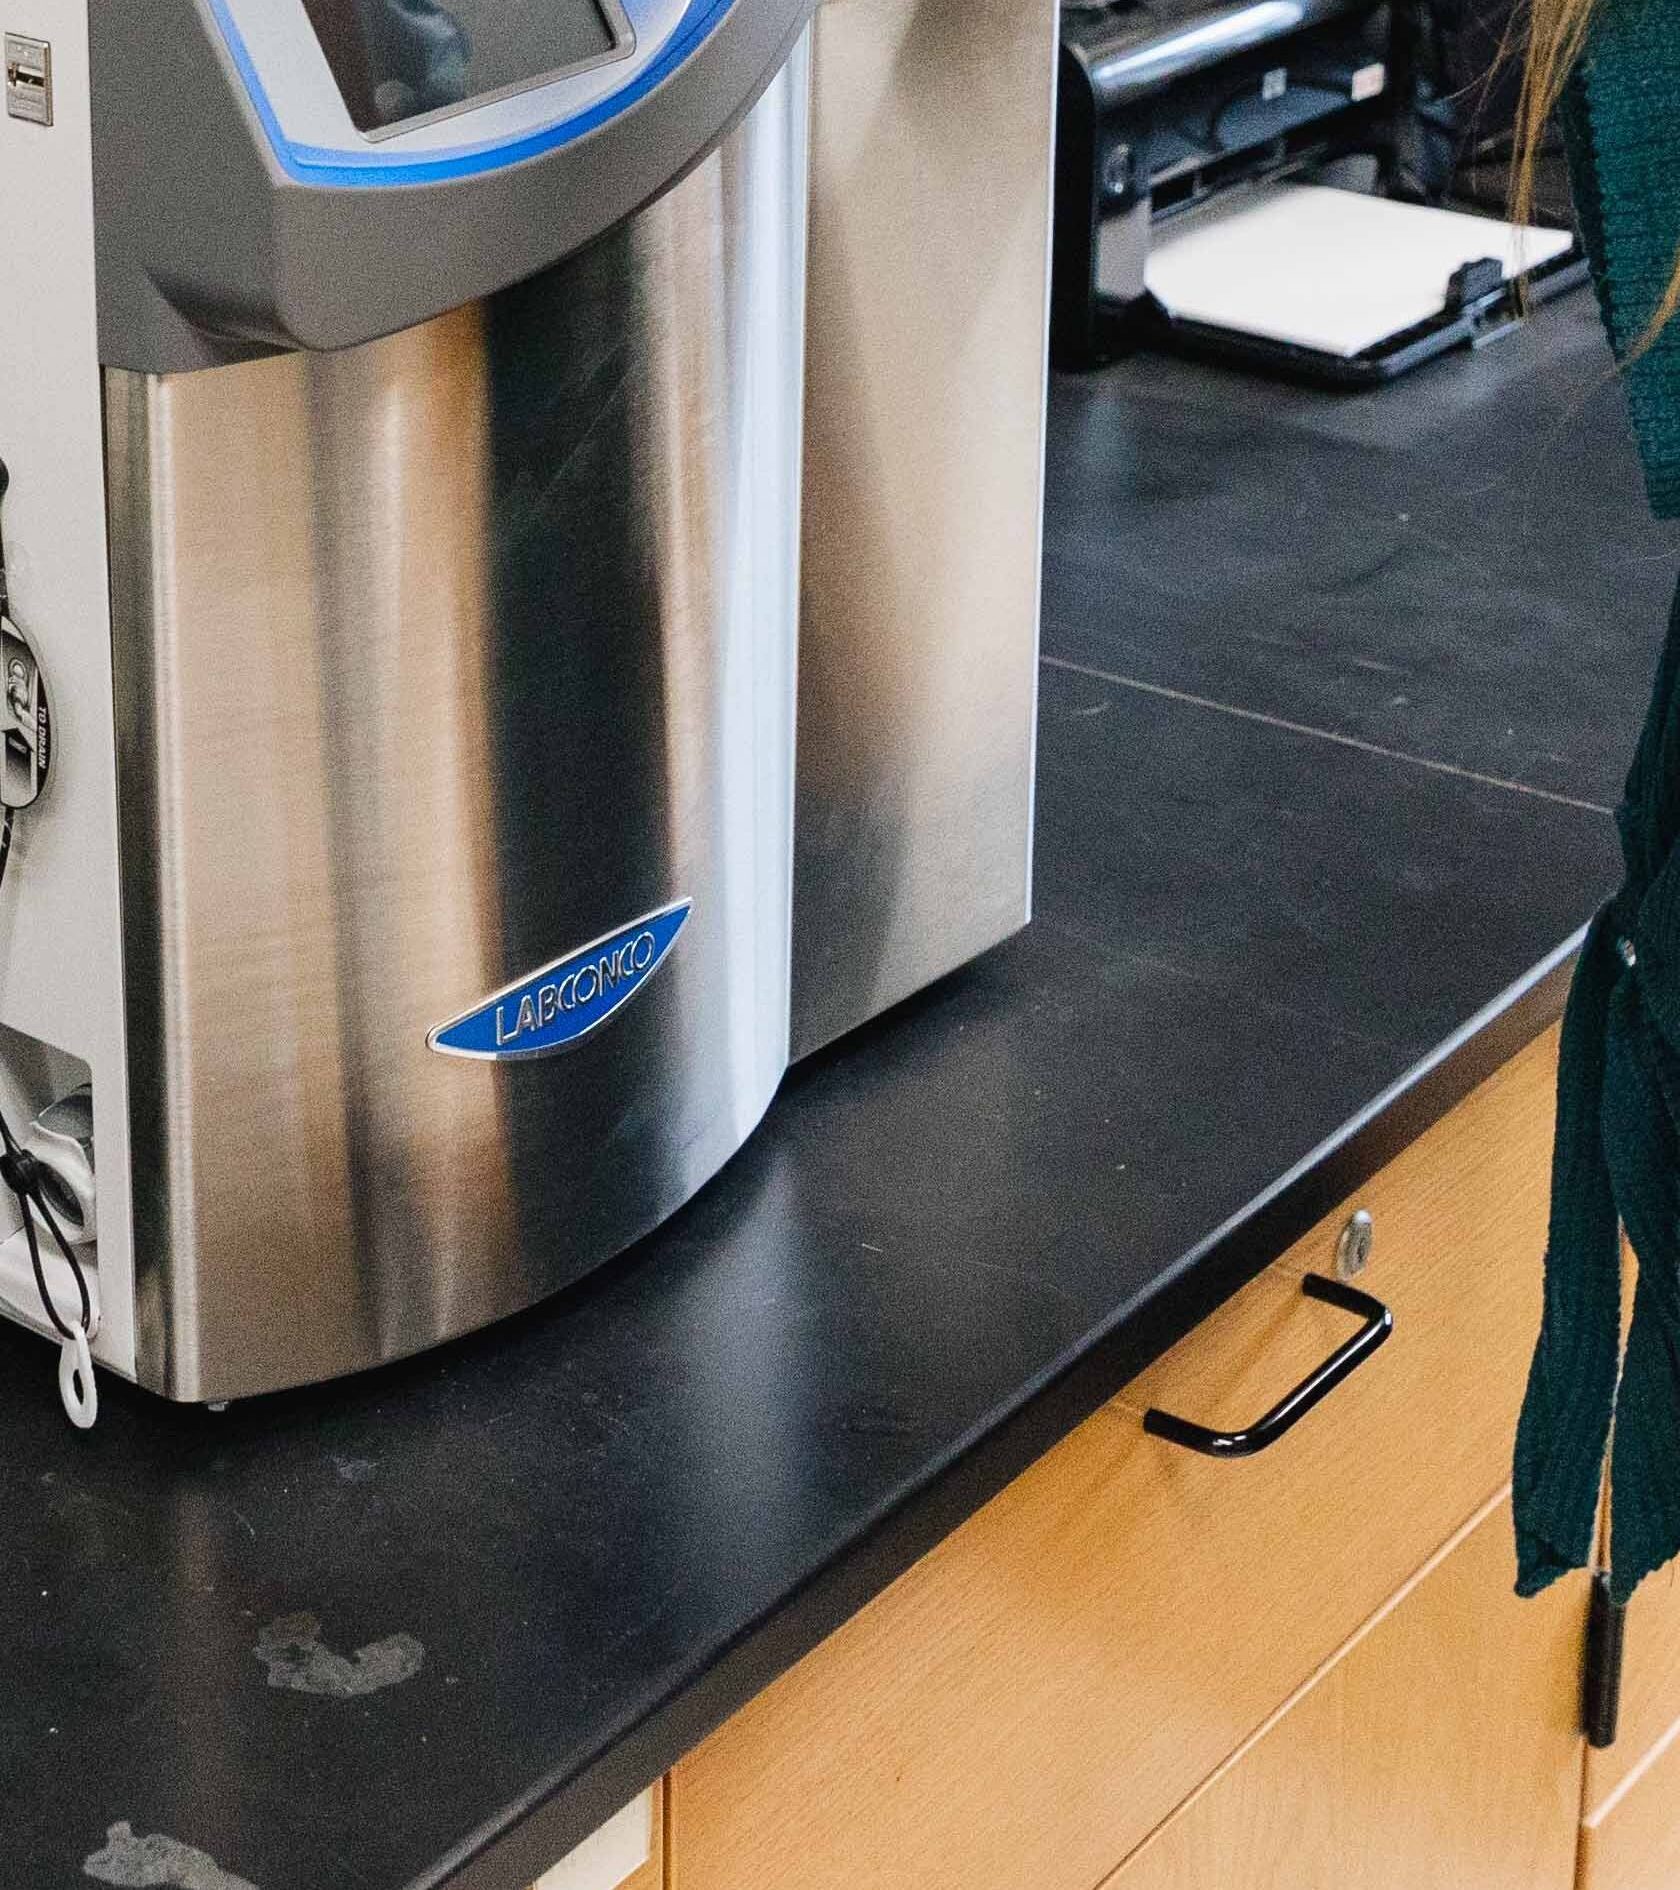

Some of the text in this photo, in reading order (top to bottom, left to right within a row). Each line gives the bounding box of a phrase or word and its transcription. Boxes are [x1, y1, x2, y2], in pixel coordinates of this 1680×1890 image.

[38, 707, 47, 769] TO DRAIN
[496, 931, 655, 1047] LABCONCO
